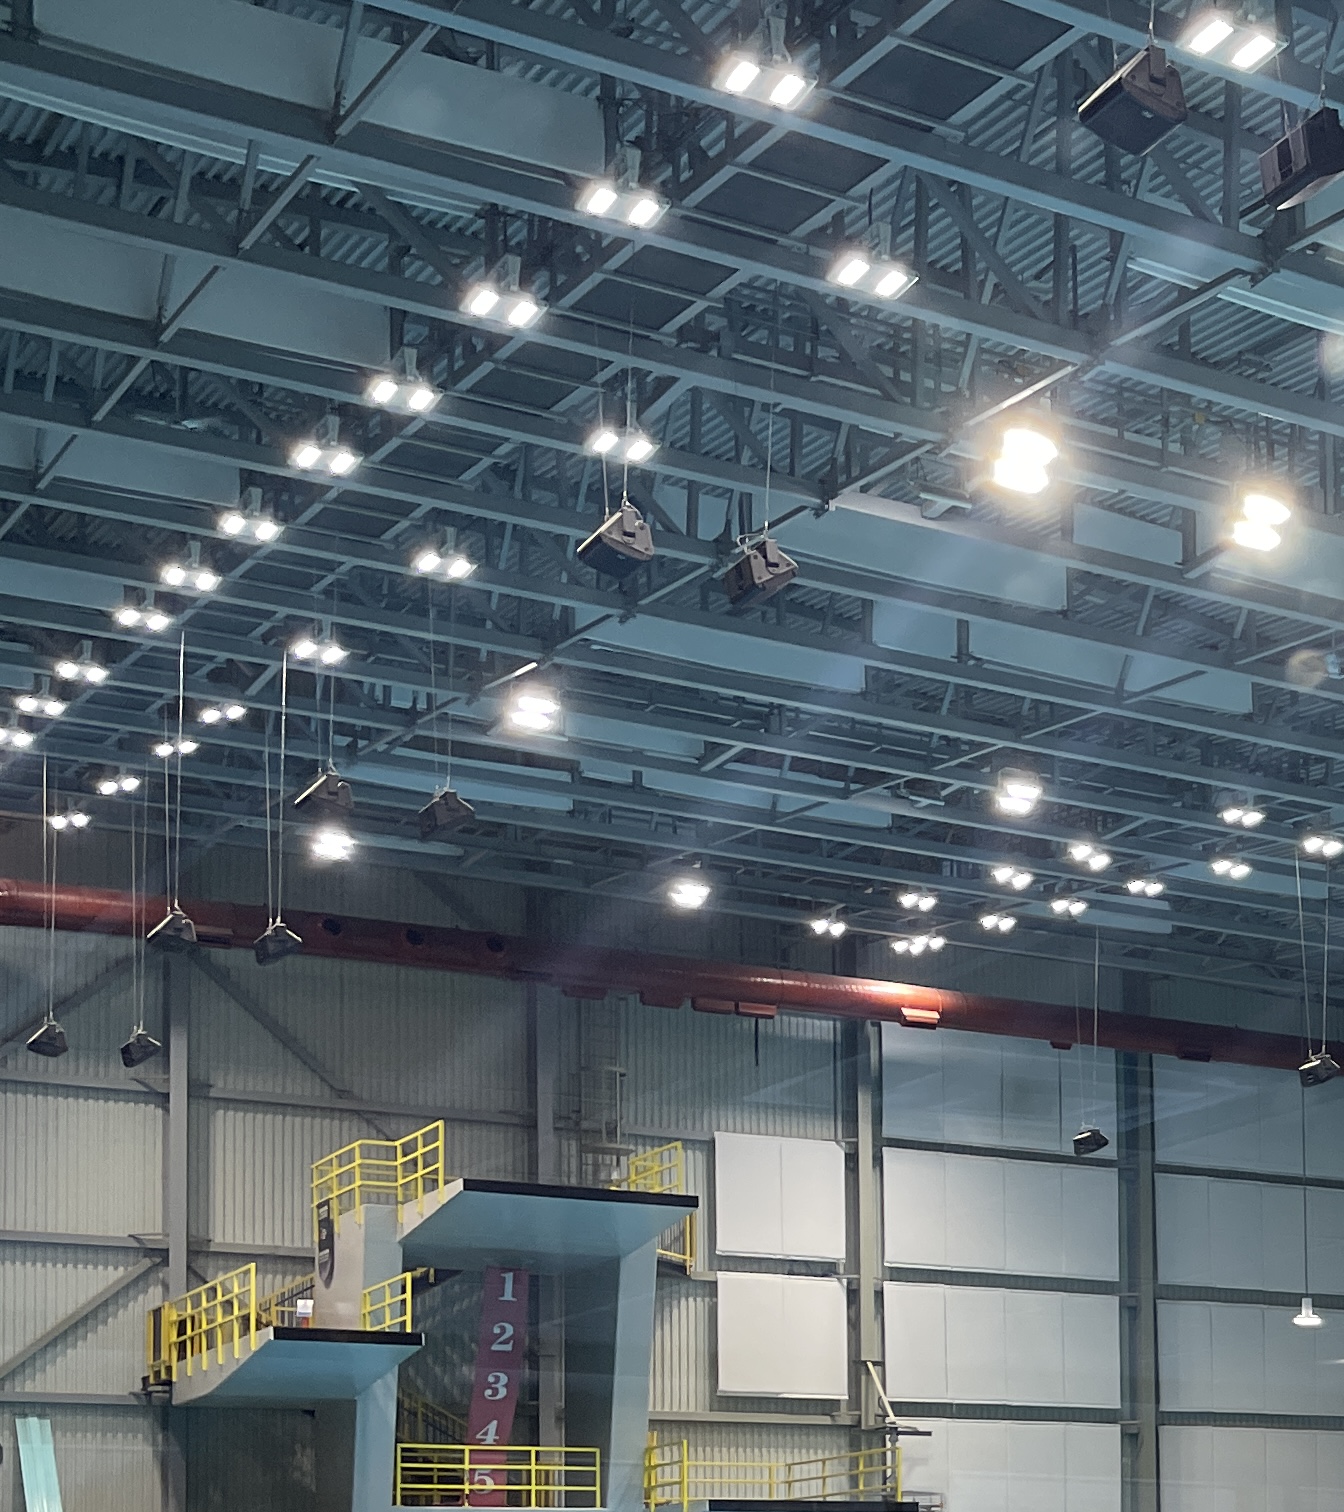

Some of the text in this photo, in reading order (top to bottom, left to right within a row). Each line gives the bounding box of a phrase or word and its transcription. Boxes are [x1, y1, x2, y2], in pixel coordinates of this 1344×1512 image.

[498, 1272, 517, 1301] 1
[490, 1322, 514, 1351] 2
[484, 1372, 508, 1400] 3
[475, 1420, 499, 1444] 4
[472, 1469, 494, 1494] 5
